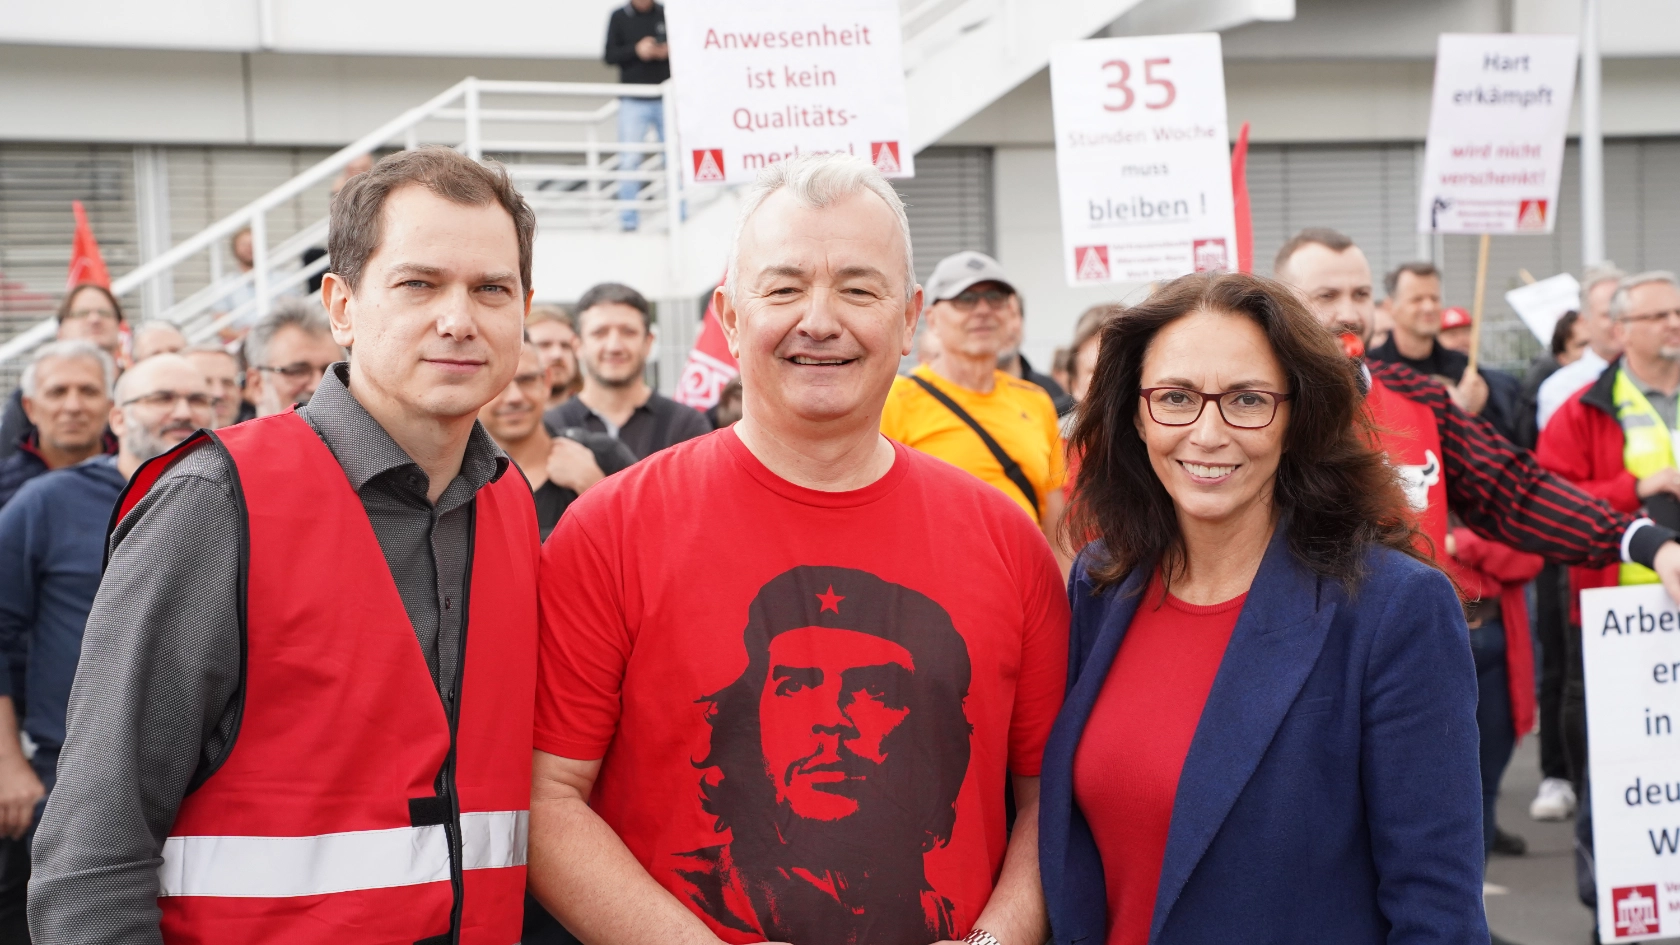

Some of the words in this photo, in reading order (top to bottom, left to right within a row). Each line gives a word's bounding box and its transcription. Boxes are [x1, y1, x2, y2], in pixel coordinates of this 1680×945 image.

[703, 24, 871, 50] Anwesenheit
[1483, 52, 1531, 71] Hart
[746, 66, 776, 89] ist
[784, 65, 836, 87] kein
[1101, 57, 1177, 112] 35
[1453, 85, 1553, 109] erkämpft
[733, 105, 858, 132] Qualitäts-
[1068, 130, 1147, 148] Stunden
[1153, 124, 1217, 142] Woche
[1451, 142, 1493, 160] wird
[1497, 142, 1542, 160] nicht
[1121, 163, 1170, 177] muss
[1440, 169, 1547, 186] verschenkt!
[1088, 197, 1190, 220] bleiben
[1645, 708, 1672, 736] in
